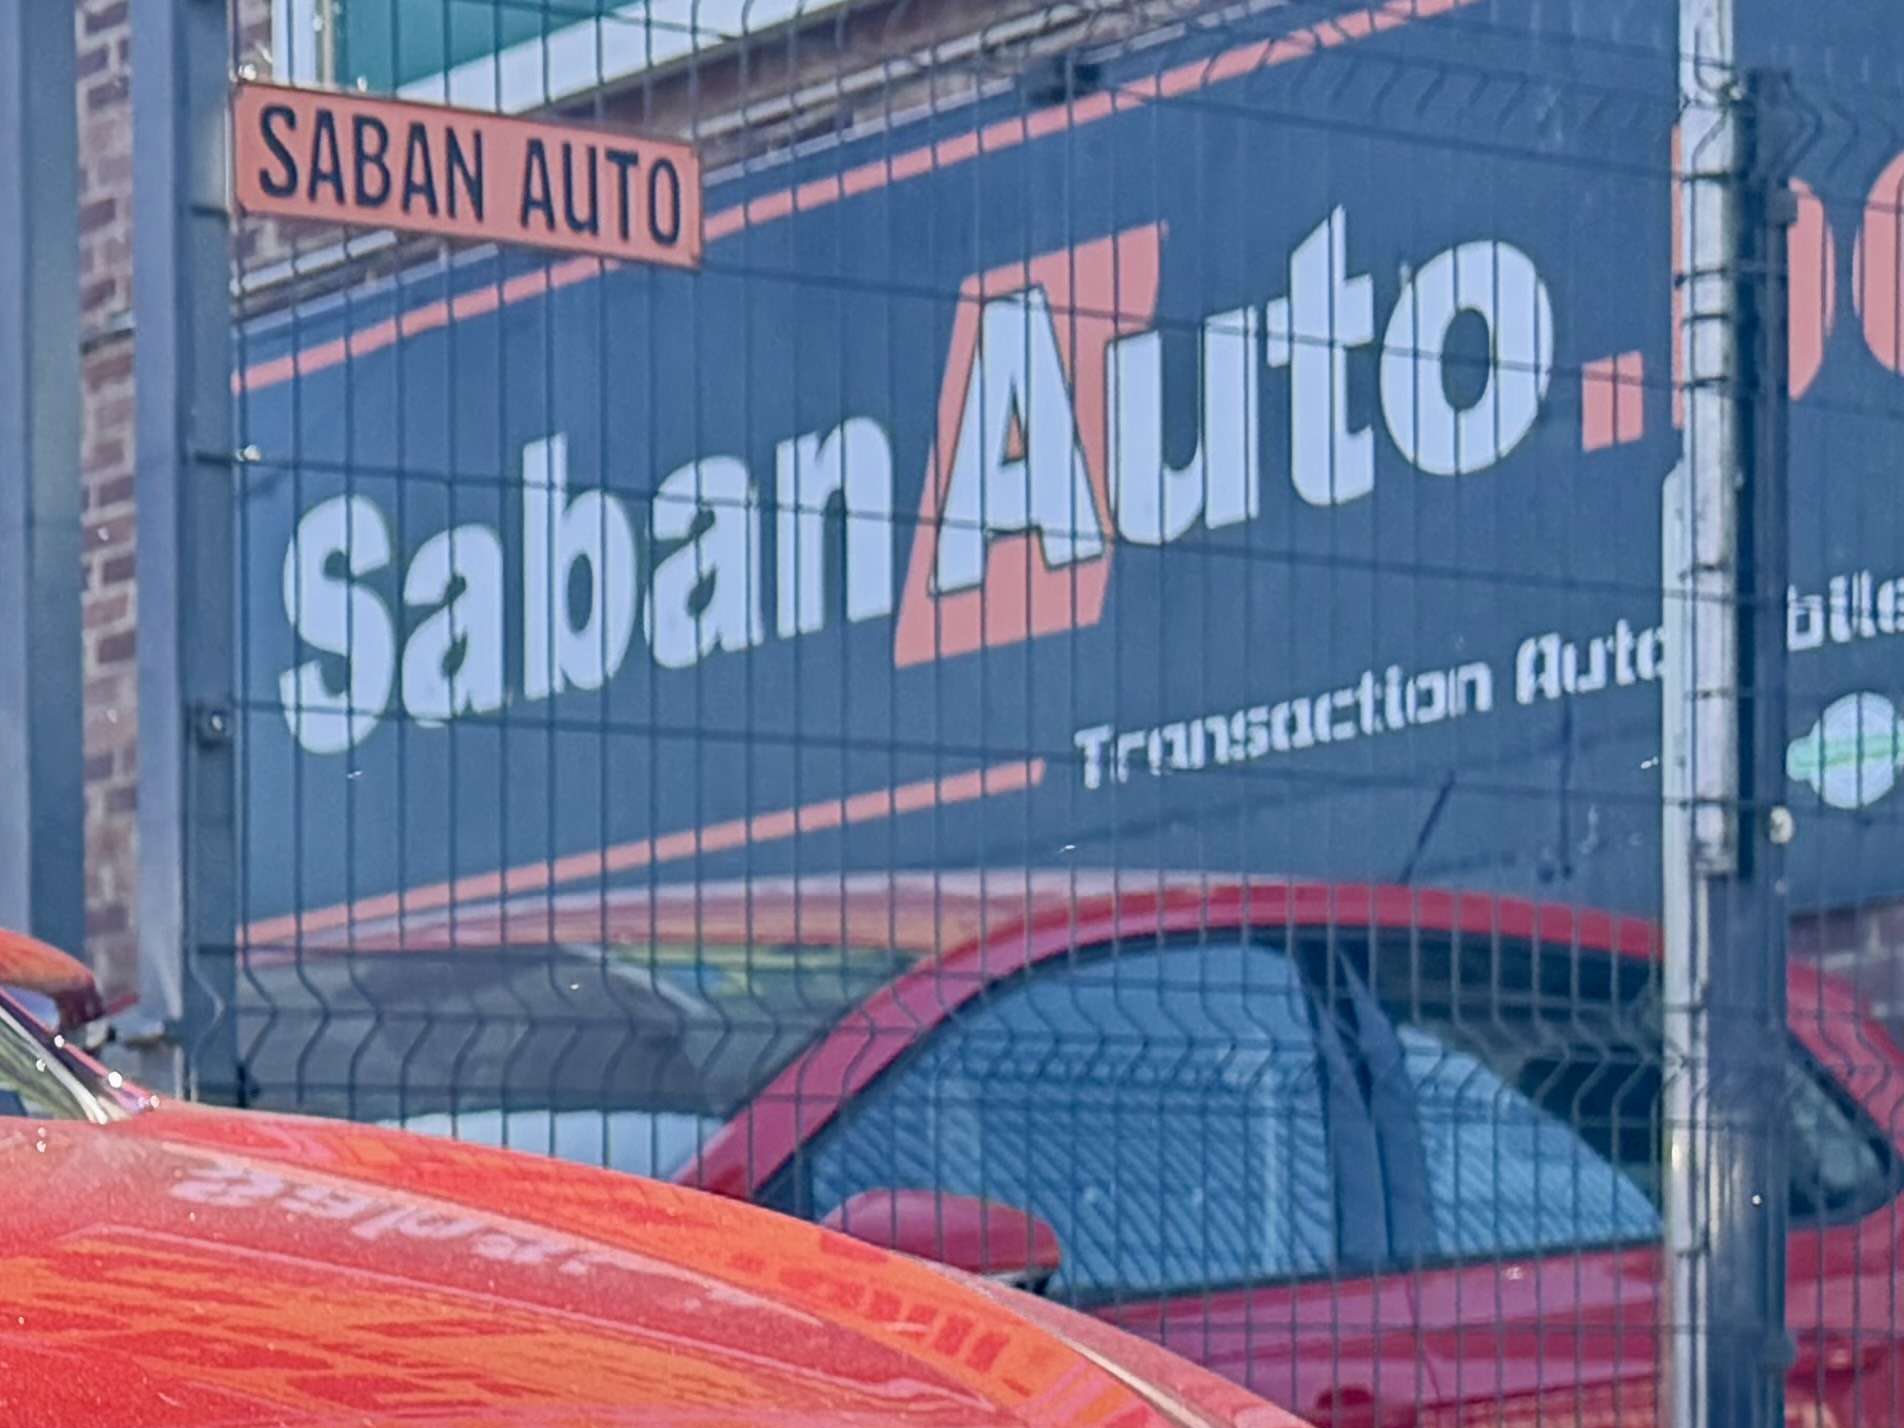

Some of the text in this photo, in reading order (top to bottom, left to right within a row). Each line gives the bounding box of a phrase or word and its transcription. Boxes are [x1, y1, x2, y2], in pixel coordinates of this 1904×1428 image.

[258, 103, 681, 247] SABAN AUTO
[1074, 570, 1904, 790] Transaction Autobile
